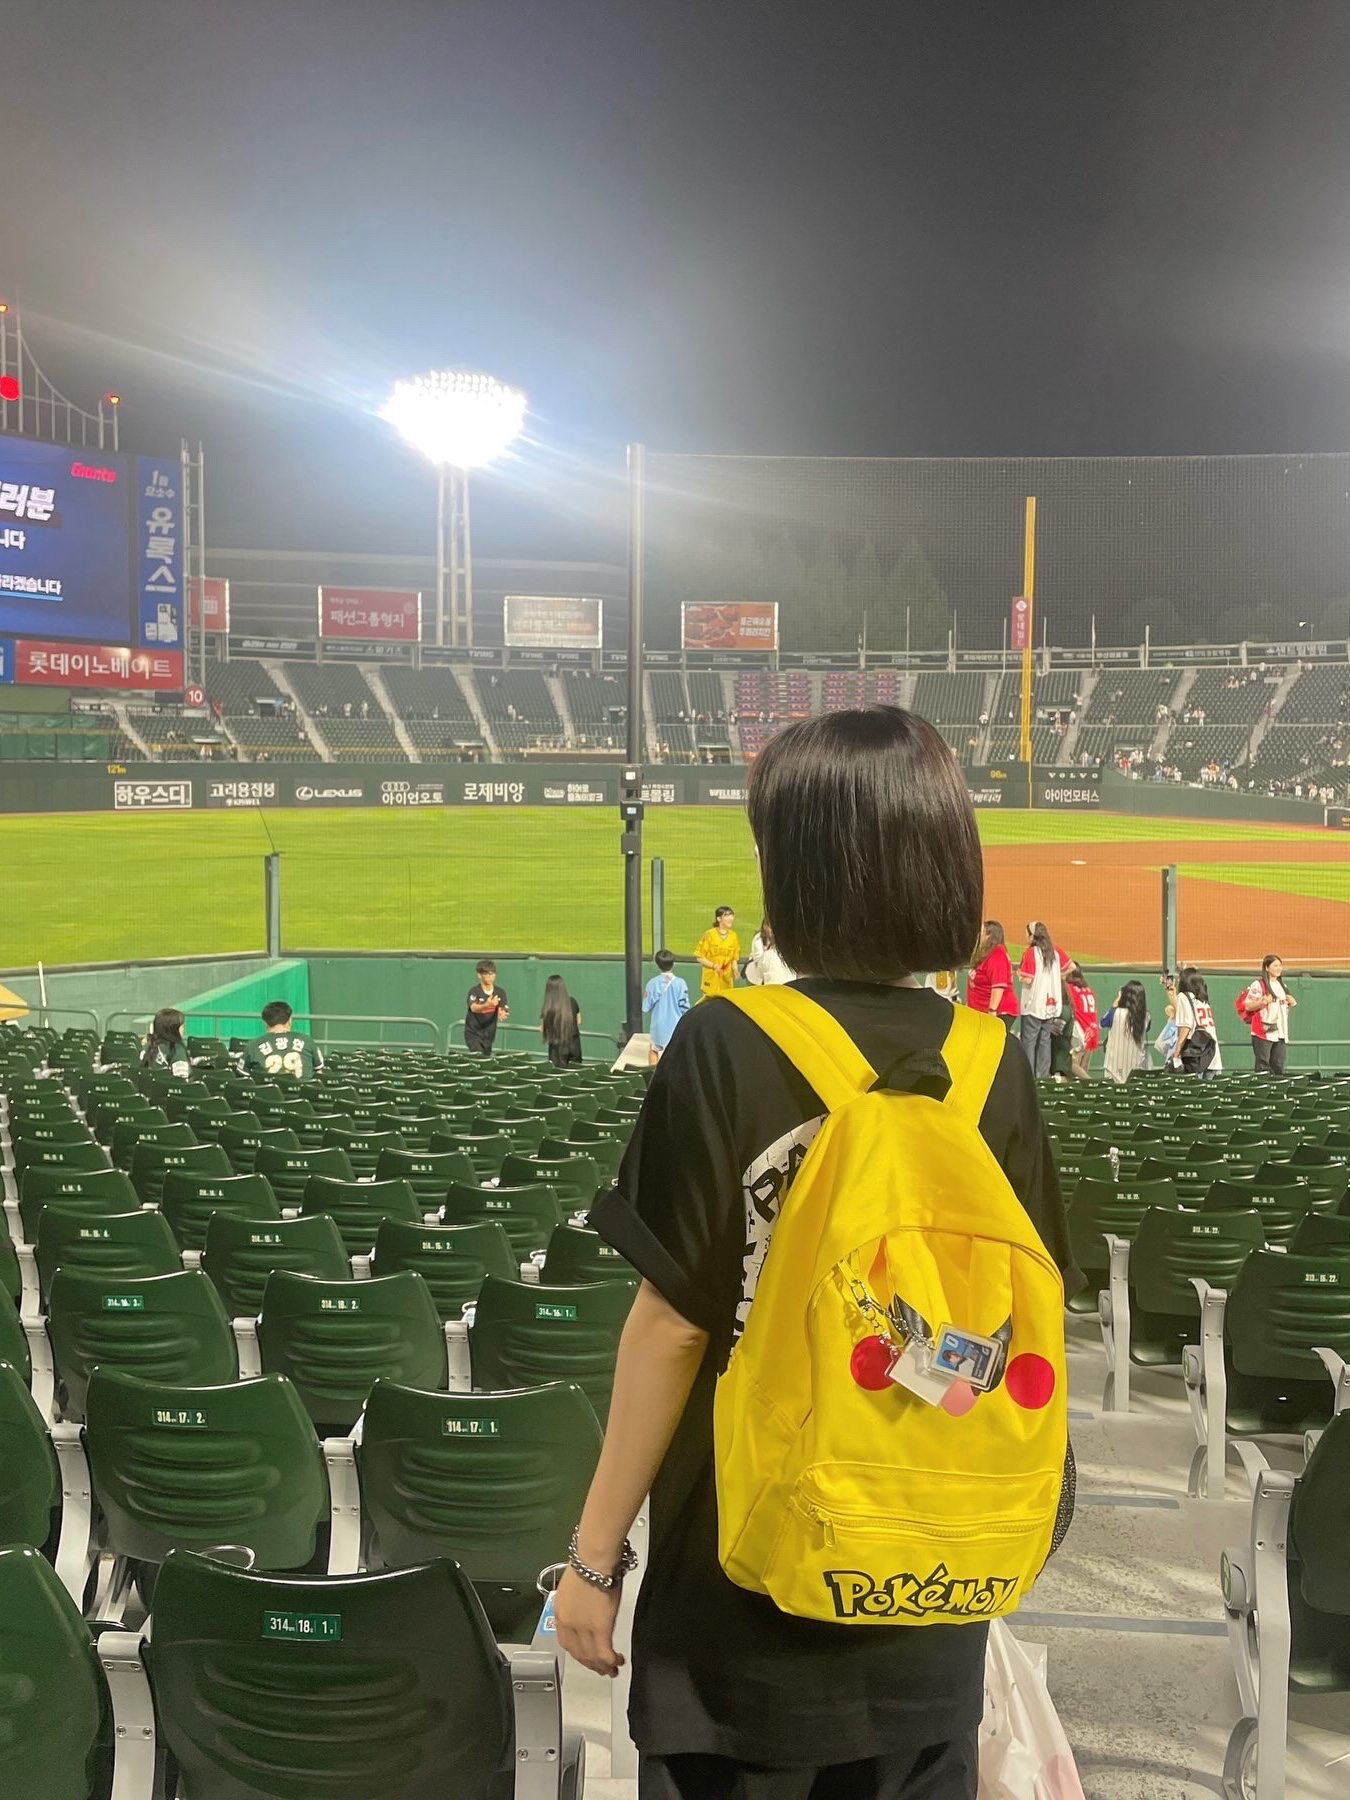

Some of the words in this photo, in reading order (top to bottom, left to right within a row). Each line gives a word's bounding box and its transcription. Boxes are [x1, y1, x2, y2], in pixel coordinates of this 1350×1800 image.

[0, 482, 55, 521] 러분
[145, 506, 177, 594] 유록스
[0, 574, 62, 595] 라겠습니다
[331, 610, 404, 628] 패션그룹형지
[28, 650, 172, 680] 롯데이노베이트
[189, 690, 203, 701] 10
[107, 765, 127, 775] 121m
[116, 785, 188, 805] 하우스디
[314, 788, 363, 798] LEXUS
[382, 791, 444, 805] 아이언오토
[463, 782, 525, 803] 로제비앙
[1045, 788, 1100, 803] 아이언모터스
[1080, 993, 1096, 1013] 19
[265, 1052, 303, 1079] 29
